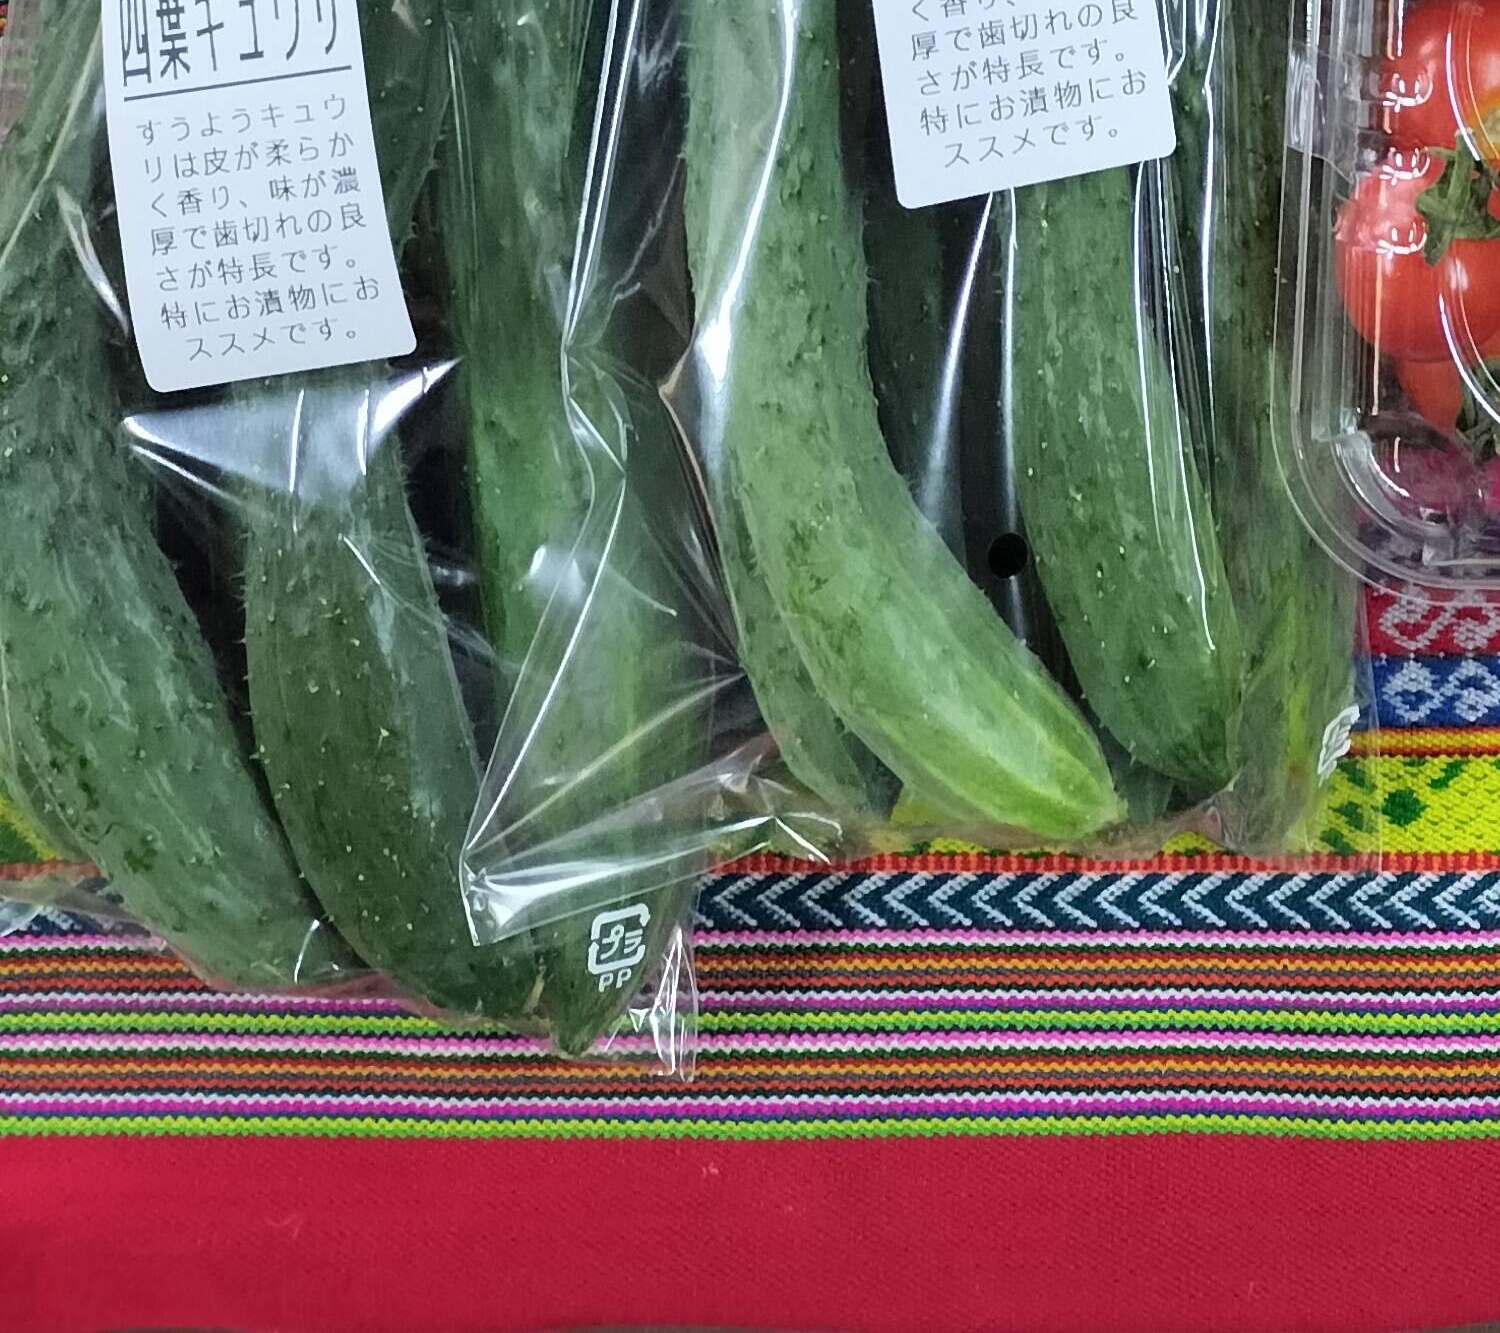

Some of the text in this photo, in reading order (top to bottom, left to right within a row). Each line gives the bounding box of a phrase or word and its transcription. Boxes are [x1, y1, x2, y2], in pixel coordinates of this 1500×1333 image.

[917, 38, 1124, 95] さが特長です。
[136, 94, 345, 146] すうようキュウ
[920, 69, 1146, 136] 特にお漬物にお
[145, 131, 354, 183] リは皮が柔らか
[945, 115, 1117, 168] ススメです。
[151, 202, 367, 256] 厚で歯切れの良
[156, 244, 355, 291] さが特長です。
[161, 275, 379, 331] 特にお漬物にお
[186, 317, 356, 361] ススメです。
[601, 924, 643, 960] プラ
[598, 968, 632, 993] PP
